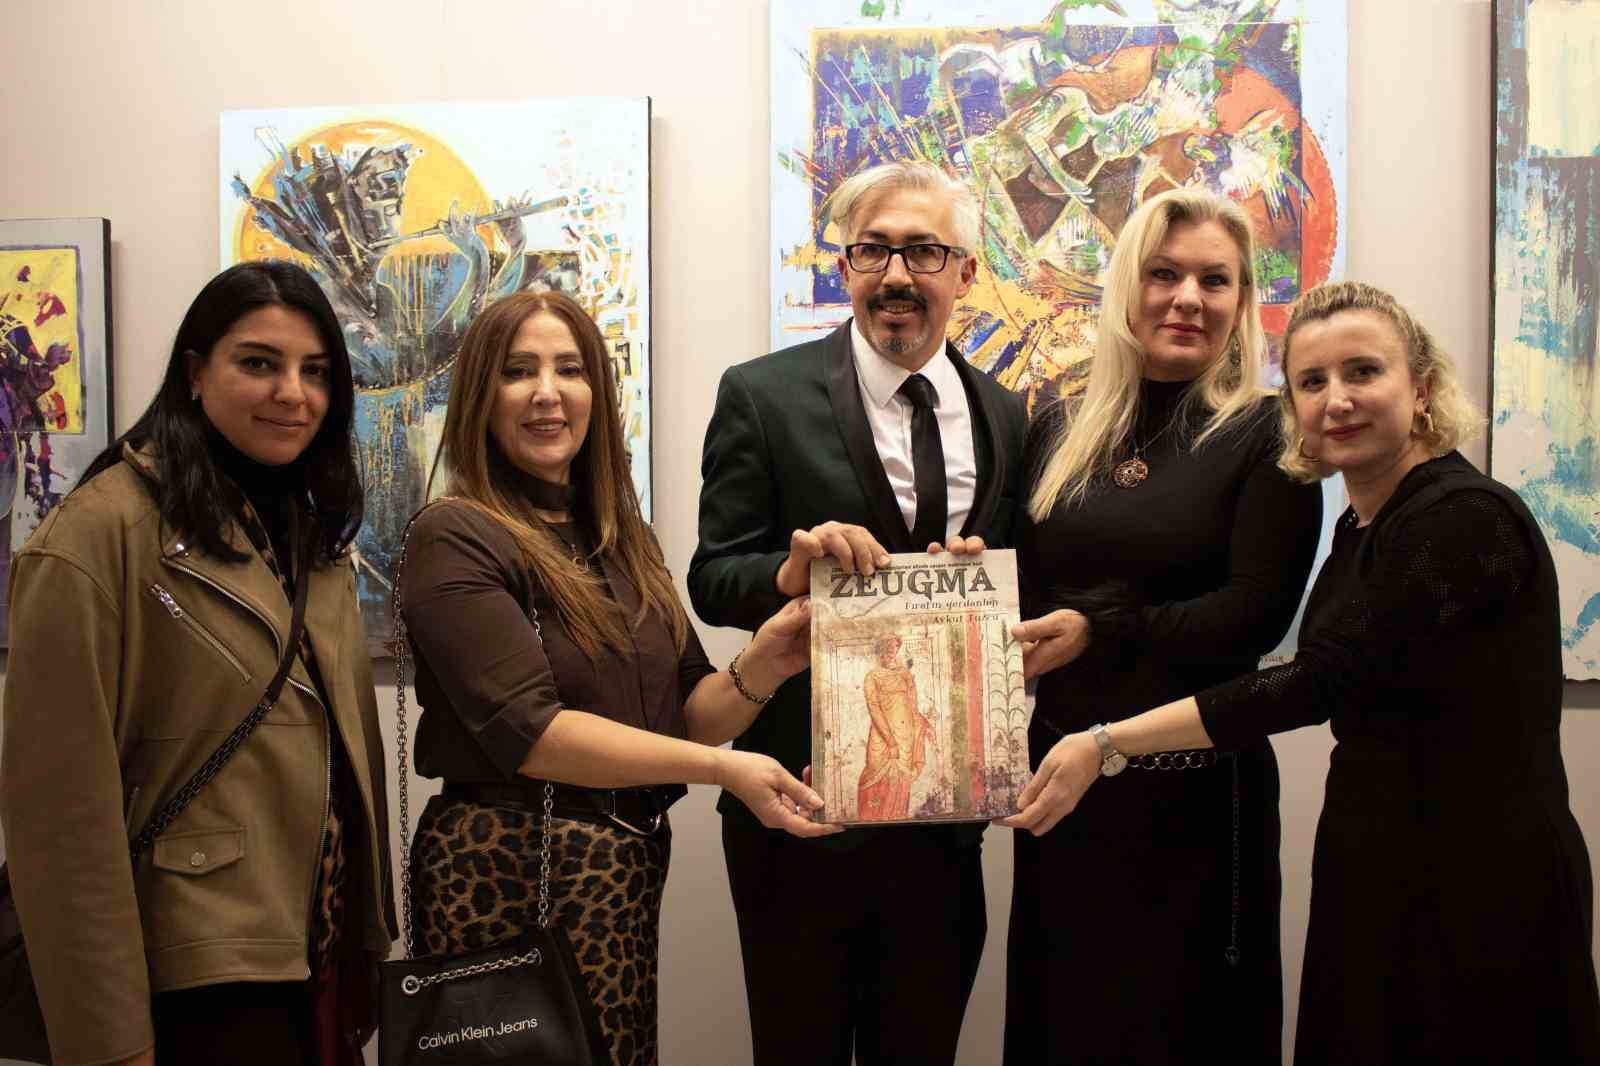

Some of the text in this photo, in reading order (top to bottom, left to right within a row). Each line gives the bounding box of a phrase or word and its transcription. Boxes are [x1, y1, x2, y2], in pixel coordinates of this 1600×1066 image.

[830, 567, 997, 600] ZEUGMA
[418, 1017, 538, 1050] Calvin Klein Jeans
